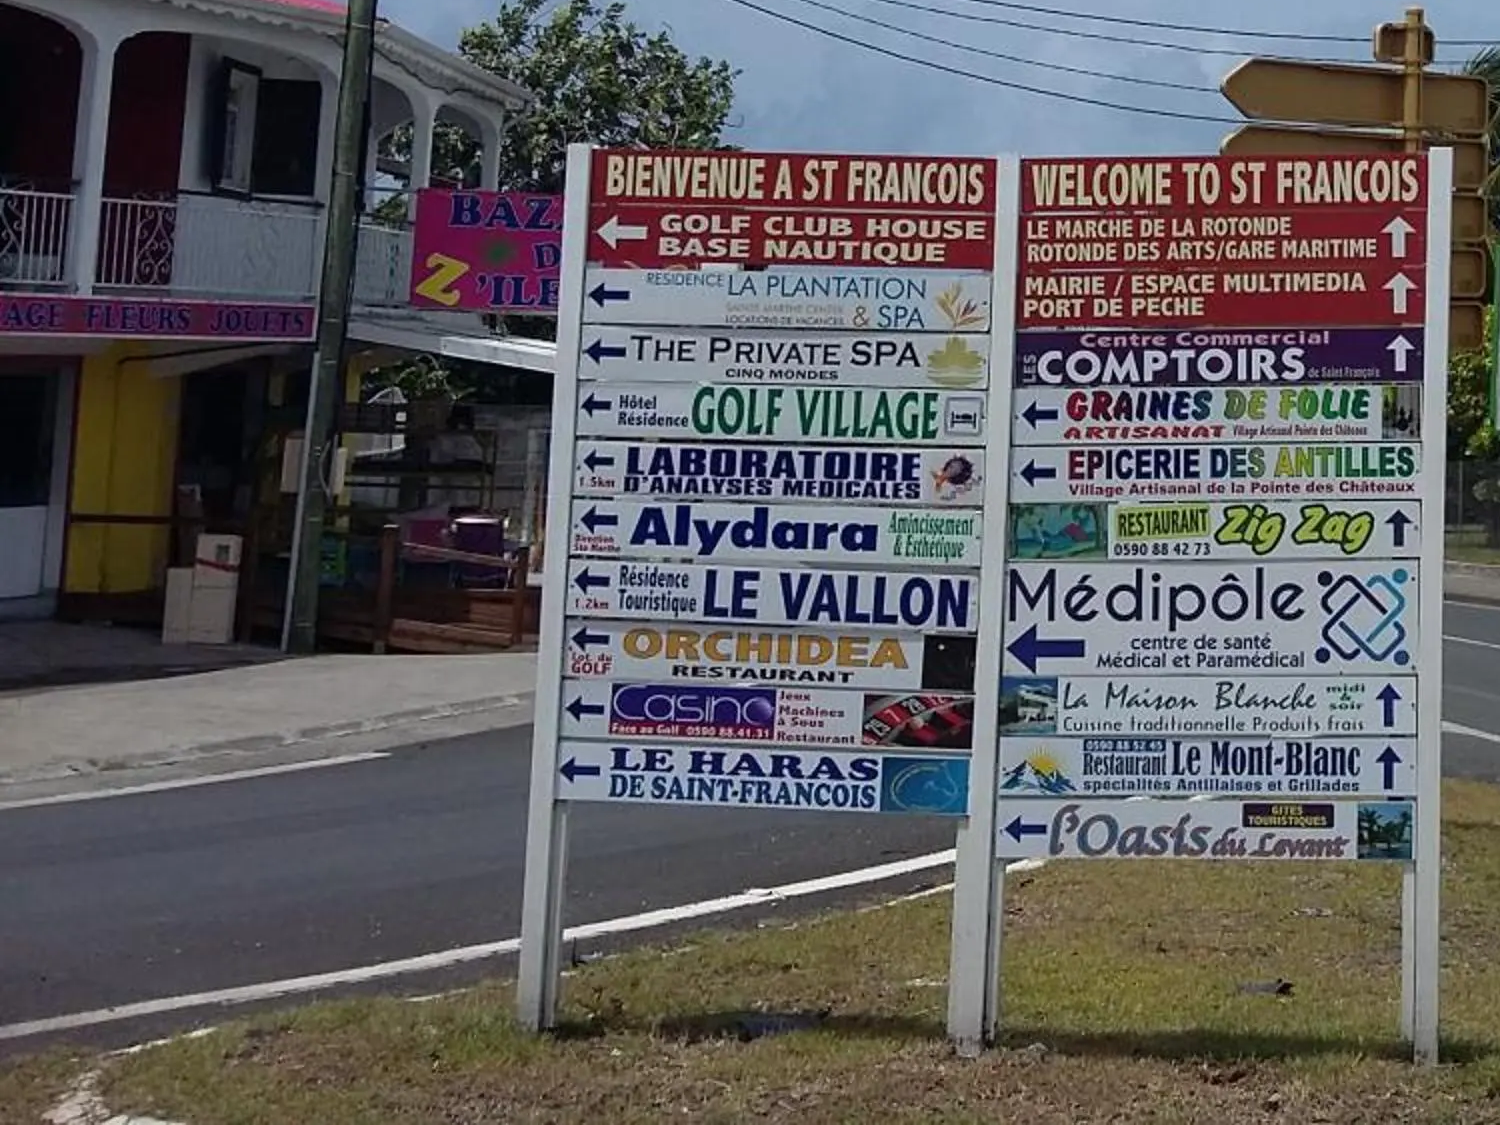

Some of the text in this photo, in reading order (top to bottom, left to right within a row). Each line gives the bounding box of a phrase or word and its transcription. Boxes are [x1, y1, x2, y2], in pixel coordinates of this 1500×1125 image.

[606, 155, 985, 205] BIENVENUE A ST FRANCOIS
[1032, 159, 1419, 206] WELCOME TO ST FRANCOIS
[449, 192, 563, 232] BAZ
[660, 214, 987, 240] GOLF CLUB HOUSE
[1027, 216, 1292, 240] LE MARCHE DE LA ROTONDE
[658, 237, 946, 264] BASE NAUTIQUE
[1027, 242, 1117, 263] ROTONDE
[1123, 242, 1160, 261] DES
[1281, 238, 1377, 259] MARITIME
[728, 275, 757, 296] LA
[766, 275, 927, 300] PLANTATION
[1025, 272, 1367, 296] MAIRIE ESPACE MULTIMEDIA
[86, 304, 192, 332] FLEURS
[209, 309, 306, 335] JOUETS
[852, 304, 925, 329] & SPA
[1023, 297, 1205, 318] PORT DE PECHE
[630, 335, 921, 368] THE PRIVATE SPA
[1080, 331, 1329, 348] Centre Commercial
[725, 368, 839, 380] CINQ MONDES
[1023, 348, 1305, 384] LES COMPTOIRS
[619, 394, 657, 410] Hôtel
[692, 386, 940, 440] GOLF VILLAGE
[1066, 388, 1371, 421] GRAINES DE FOLIE
[618, 411, 689, 428] Résidence
[1064, 425, 1226, 439] ARTISANAT
[626, 446, 921, 481] LABORATOIRE
[1069, 446, 1415, 480] EPICERIE DES ANTILLES
[624, 477, 773, 495] D'ANALYSES
[783, 480, 921, 499] MEDICALES
[1069, 481, 1415, 497] Village Artisanal de la Pointe des Châteaux
[630, 505, 879, 555] Alydara
[889, 511, 975, 536] Amincissement
[1118, 508, 1209, 537] RESTAURANT
[1215, 504, 1375, 555] Zig Zag
[1114, 543, 1211, 556] 0590 88 42 73
[619, 565, 689, 588] Résidence
[618, 589, 697, 617] Touristique
[703, 569, 970, 627] LE VALLON
[1008, 567, 1305, 632] Médipôle
[623, 628, 909, 669] ORCHIDEA
[1130, 633, 1271, 650] centre de santé
[571, 662, 612, 674] GOLF
[1096, 651, 1305, 668] Médical et Paramédical
[671, 665, 855, 683] RESTAURANT
[613, 684, 774, 724] Casino
[1063, 681, 1317, 711] La Maison Blanche
[779, 704, 845, 718] Machines
[1063, 715, 1364, 732] Cuisine traditionnelle Produits frais
[777, 731, 855, 744] Restaurant
[610, 747, 879, 781] LE HARAS
[1083, 741, 1361, 777] Restaurant Le Mont-Blanc
[608, 774, 876, 809] DE SAINT-FRANCOIS
[1177, 778, 1262, 792] Antillaises
[1268, 779, 1282, 792] et
[1288, 778, 1360, 792] Grillades
[1211, 827, 1247, 858] du
